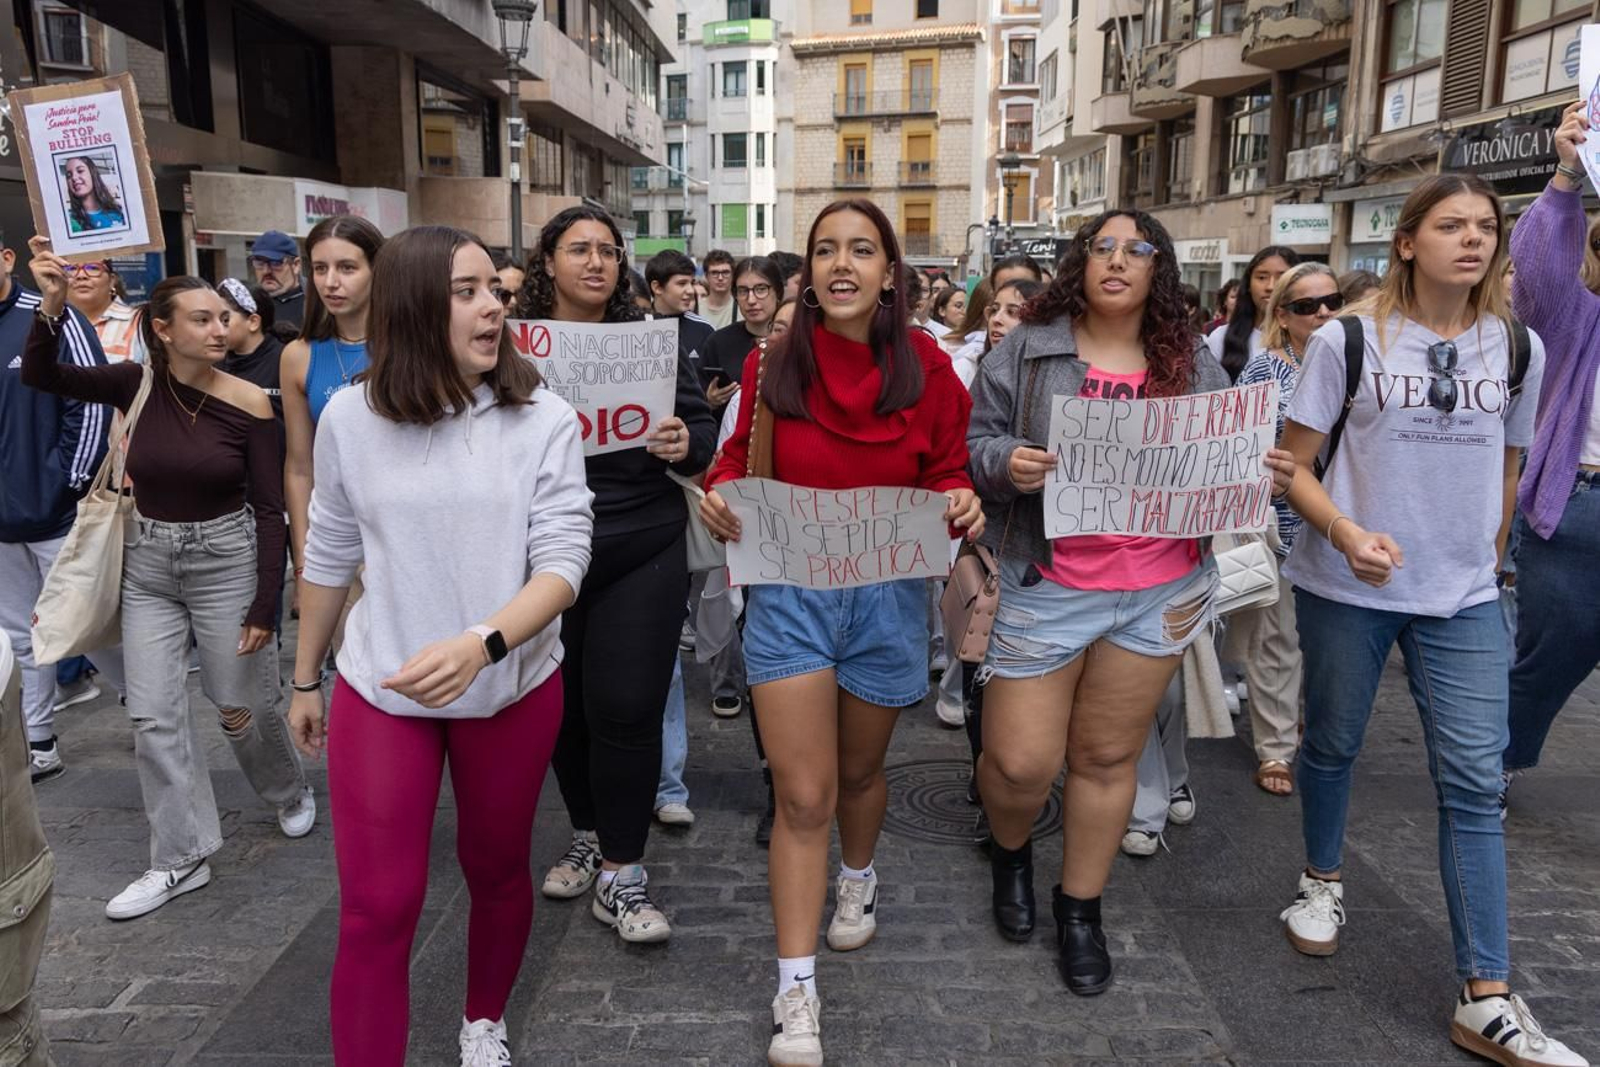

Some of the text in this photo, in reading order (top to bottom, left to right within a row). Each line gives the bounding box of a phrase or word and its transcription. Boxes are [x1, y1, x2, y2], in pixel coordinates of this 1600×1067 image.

[78, 103, 97, 115] para
[47, 116, 77, 130] Sandra
[62, 126, 94, 139] STOP
[49, 133, 112, 151] BULLYING
[1463, 128, 1556, 166] VERÓNICA Y
[1520, 165, 1545, 176] OFICIAL
[510, 322, 676, 360] NO NACIMOS
[567, 359, 676, 386] SOPORTAR
[552, 384, 589, 404] EL
[1062, 399, 1132, 444] SER
[1142, 383, 1275, 445] DIFERENTE
[1413, 416, 1433, 424] SINCE
[1397, 432, 1415, 440] ONLY
[1431, 435, 1454, 443] PLANS
[1455, 437, 1487, 445] ALLOWED
[1055, 432, 1262, 488] NO ES MOTIVO PARA
[1055, 475, 1273, 536] SER MALTRATADO
[757, 505, 917, 556] NO SE PIDE
[759, 541, 800, 583] SE
